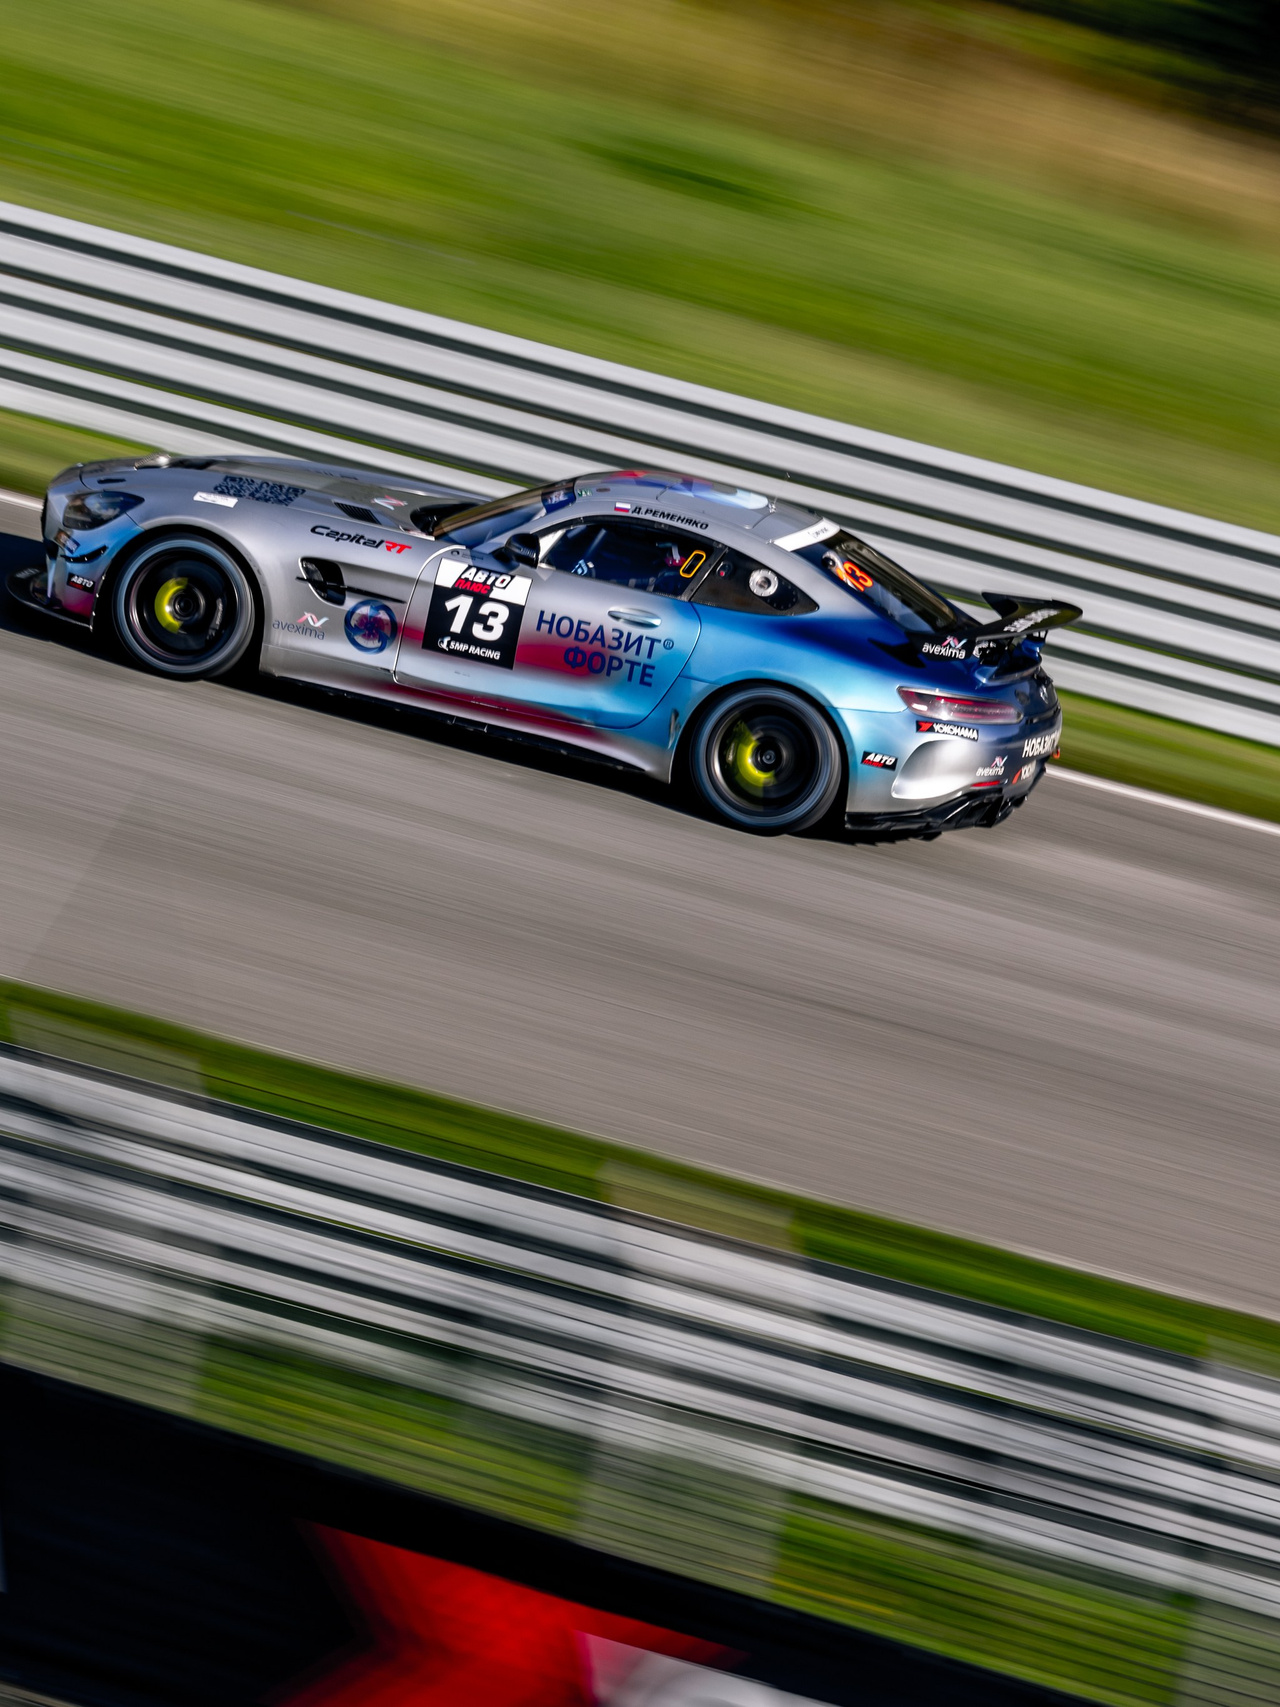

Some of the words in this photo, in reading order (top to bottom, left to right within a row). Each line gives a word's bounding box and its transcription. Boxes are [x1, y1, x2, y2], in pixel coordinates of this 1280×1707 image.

[454, 578, 491, 594] ПЛЮС
[460, 567, 512, 588] АВТО
[444, 593, 510, 641] 13
[272, 620, 326, 640] avexima
[449, 641, 469, 652] SMP
[468, 645, 501, 660] RACING
[922, 642, 966, 660] avexima
[563, 646, 656, 688] ФОРТЕ
[932, 722, 978, 740] YOKOHAMA
